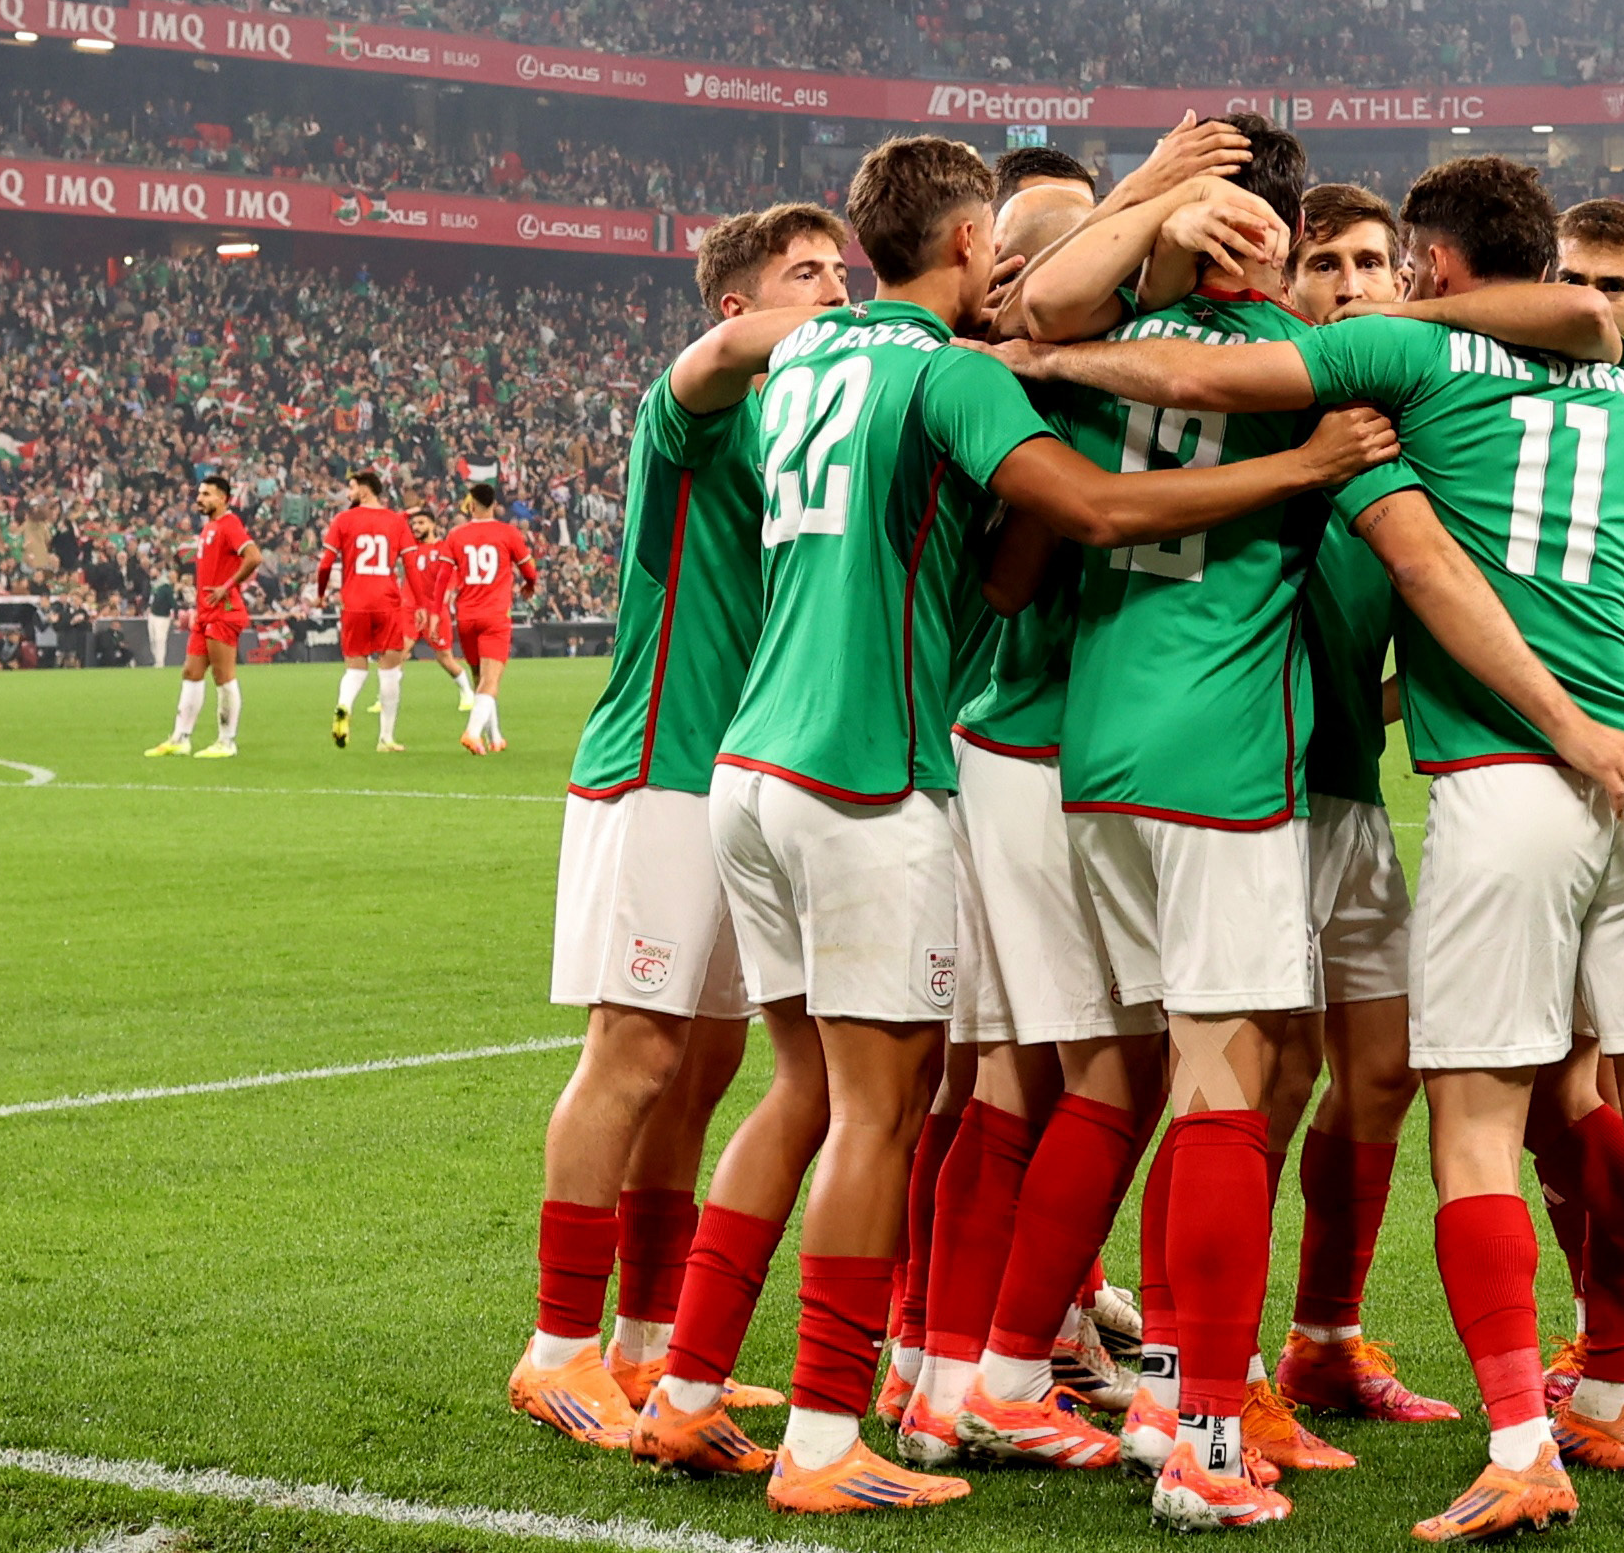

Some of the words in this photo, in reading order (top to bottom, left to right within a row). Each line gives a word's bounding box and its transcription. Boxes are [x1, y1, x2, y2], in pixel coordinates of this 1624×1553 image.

[137, 9, 206, 50] IMQ
[227, 20, 293, 61] IMQ
[364, 42, 430, 63] LEXUS
[539, 62, 600, 82] LEXUS
[968, 88, 1095, 122] Petronor
[1327, 96, 1484, 121] ATHLETIC
[45, 174, 117, 214] IMQ
[139, 182, 209, 220] IMQ
[225, 188, 293, 228] IMQ
[540, 220, 601, 239] LEXUS
[761, 355, 872, 549] 22
[1505, 394, 1609, 585] 11
[355, 534, 391, 576] 21
[463, 544, 499, 585] 19
